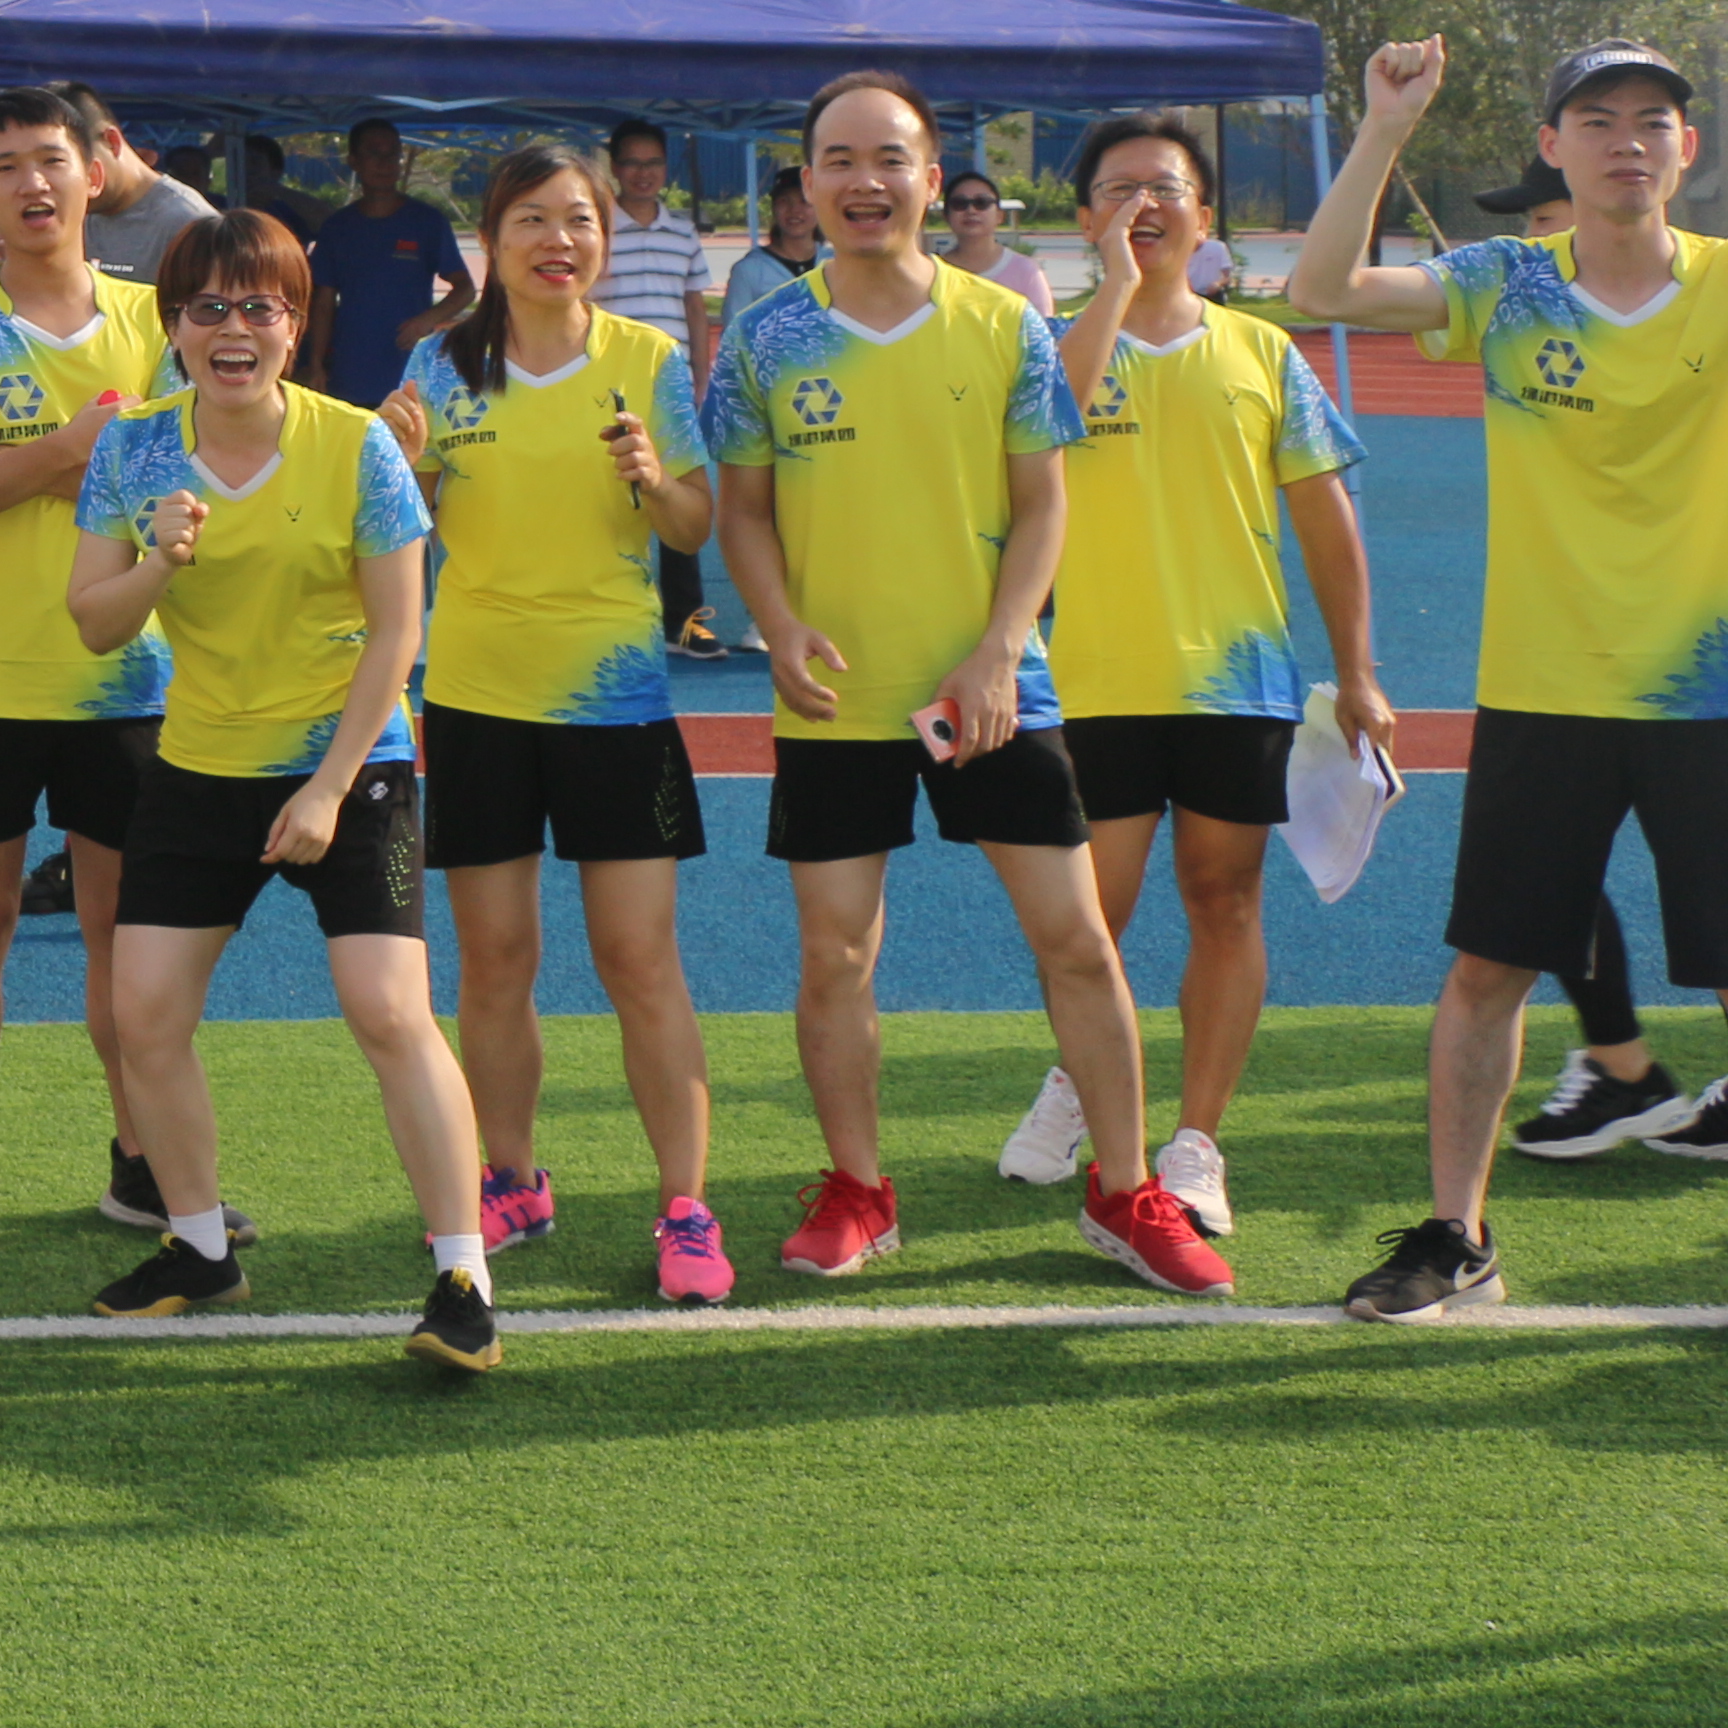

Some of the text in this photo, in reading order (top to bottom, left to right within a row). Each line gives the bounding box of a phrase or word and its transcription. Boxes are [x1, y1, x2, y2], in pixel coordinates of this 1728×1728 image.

[1520, 386, 1595, 413] 绿港集团
[788, 427, 856, 448] 绿港集团
